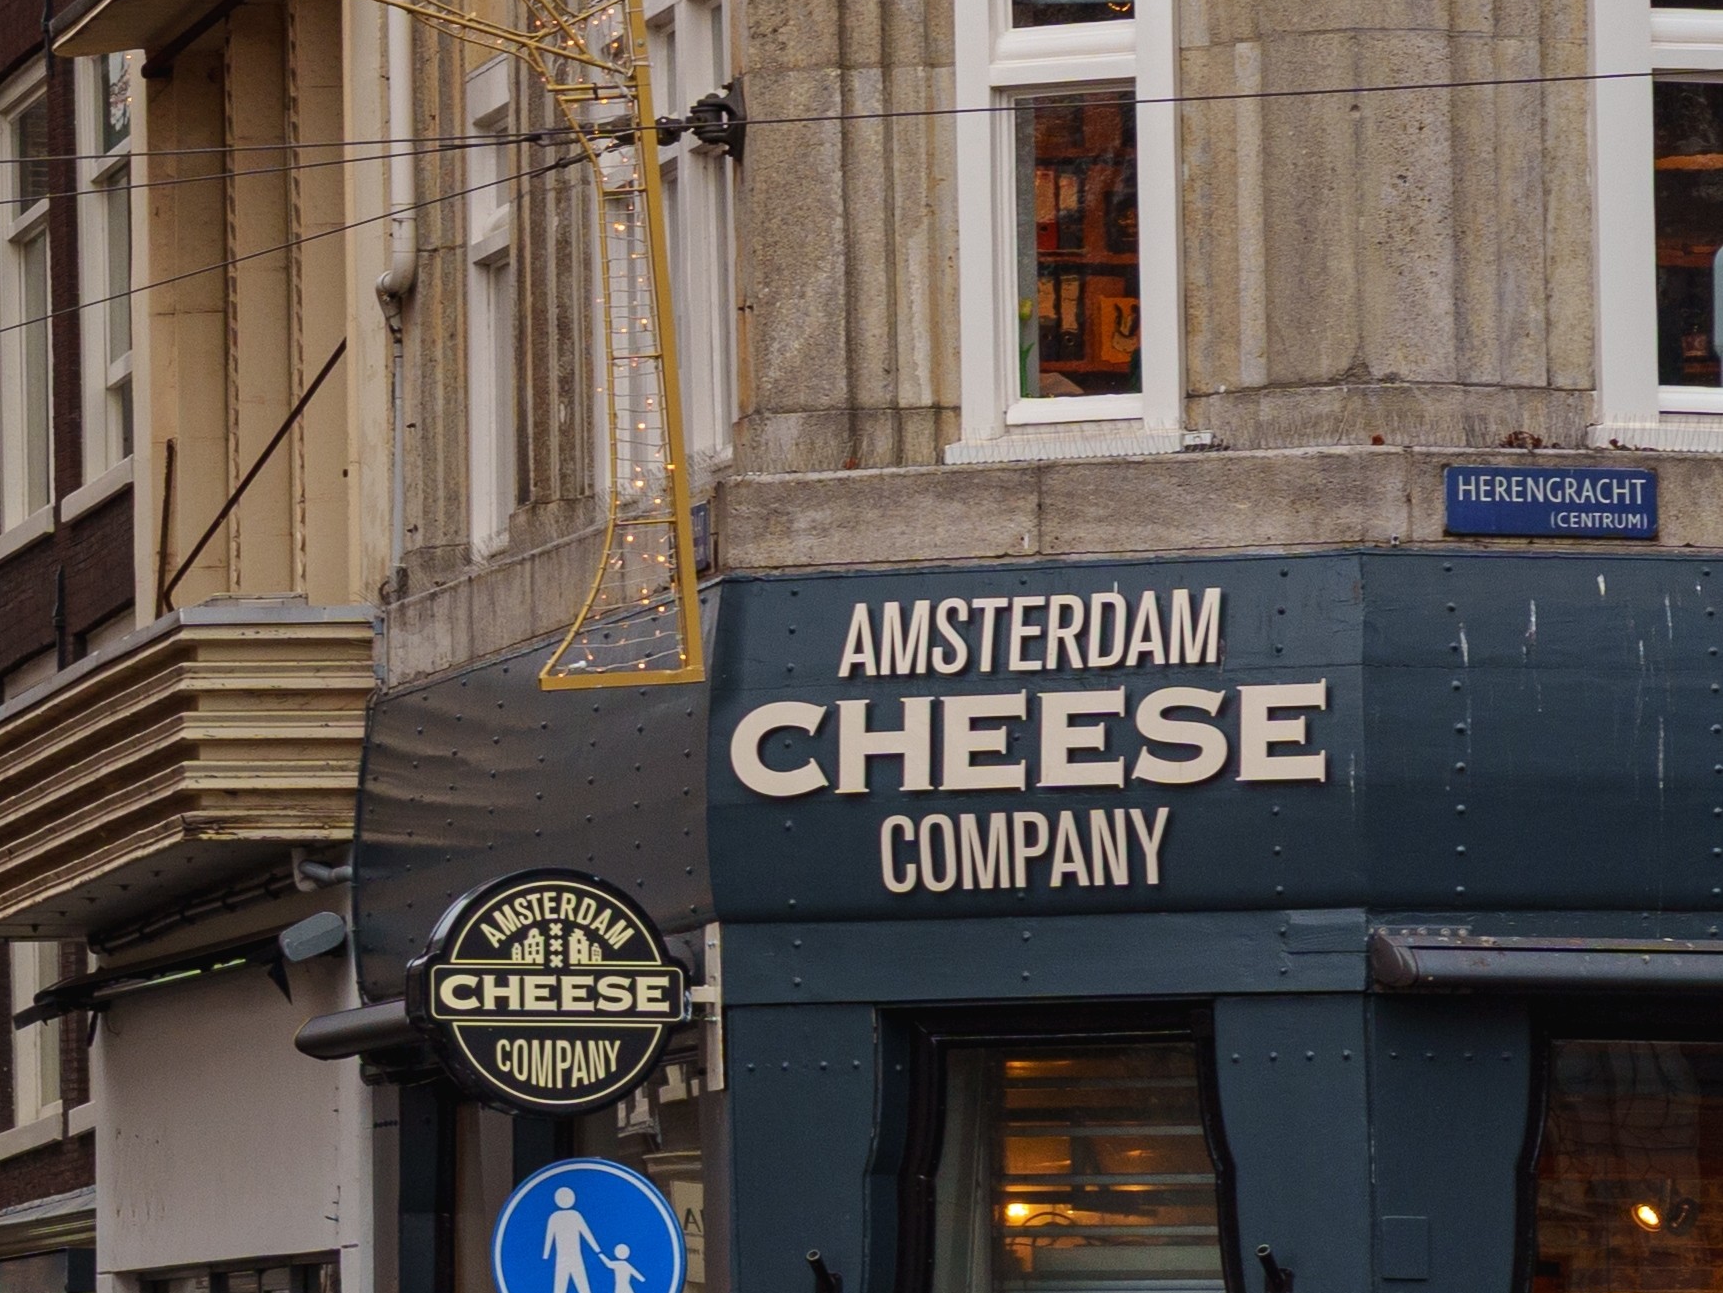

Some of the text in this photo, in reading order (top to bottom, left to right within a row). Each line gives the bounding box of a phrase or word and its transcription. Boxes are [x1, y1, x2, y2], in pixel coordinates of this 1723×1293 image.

[1457, 475, 1647, 505] HERENGRACHT
[1550, 511, 1649, 530] (CENTRUM)
[837, 586, 1222, 678] AMSTERDAM
[730, 677, 1327, 798] CHEESE
[880, 806, 1170, 894] COMPANY
[480, 892, 636, 950] AMSTERDAM
[439, 974, 670, 1012] CHEESE
[496, 1038, 621, 1089] COMPANY
